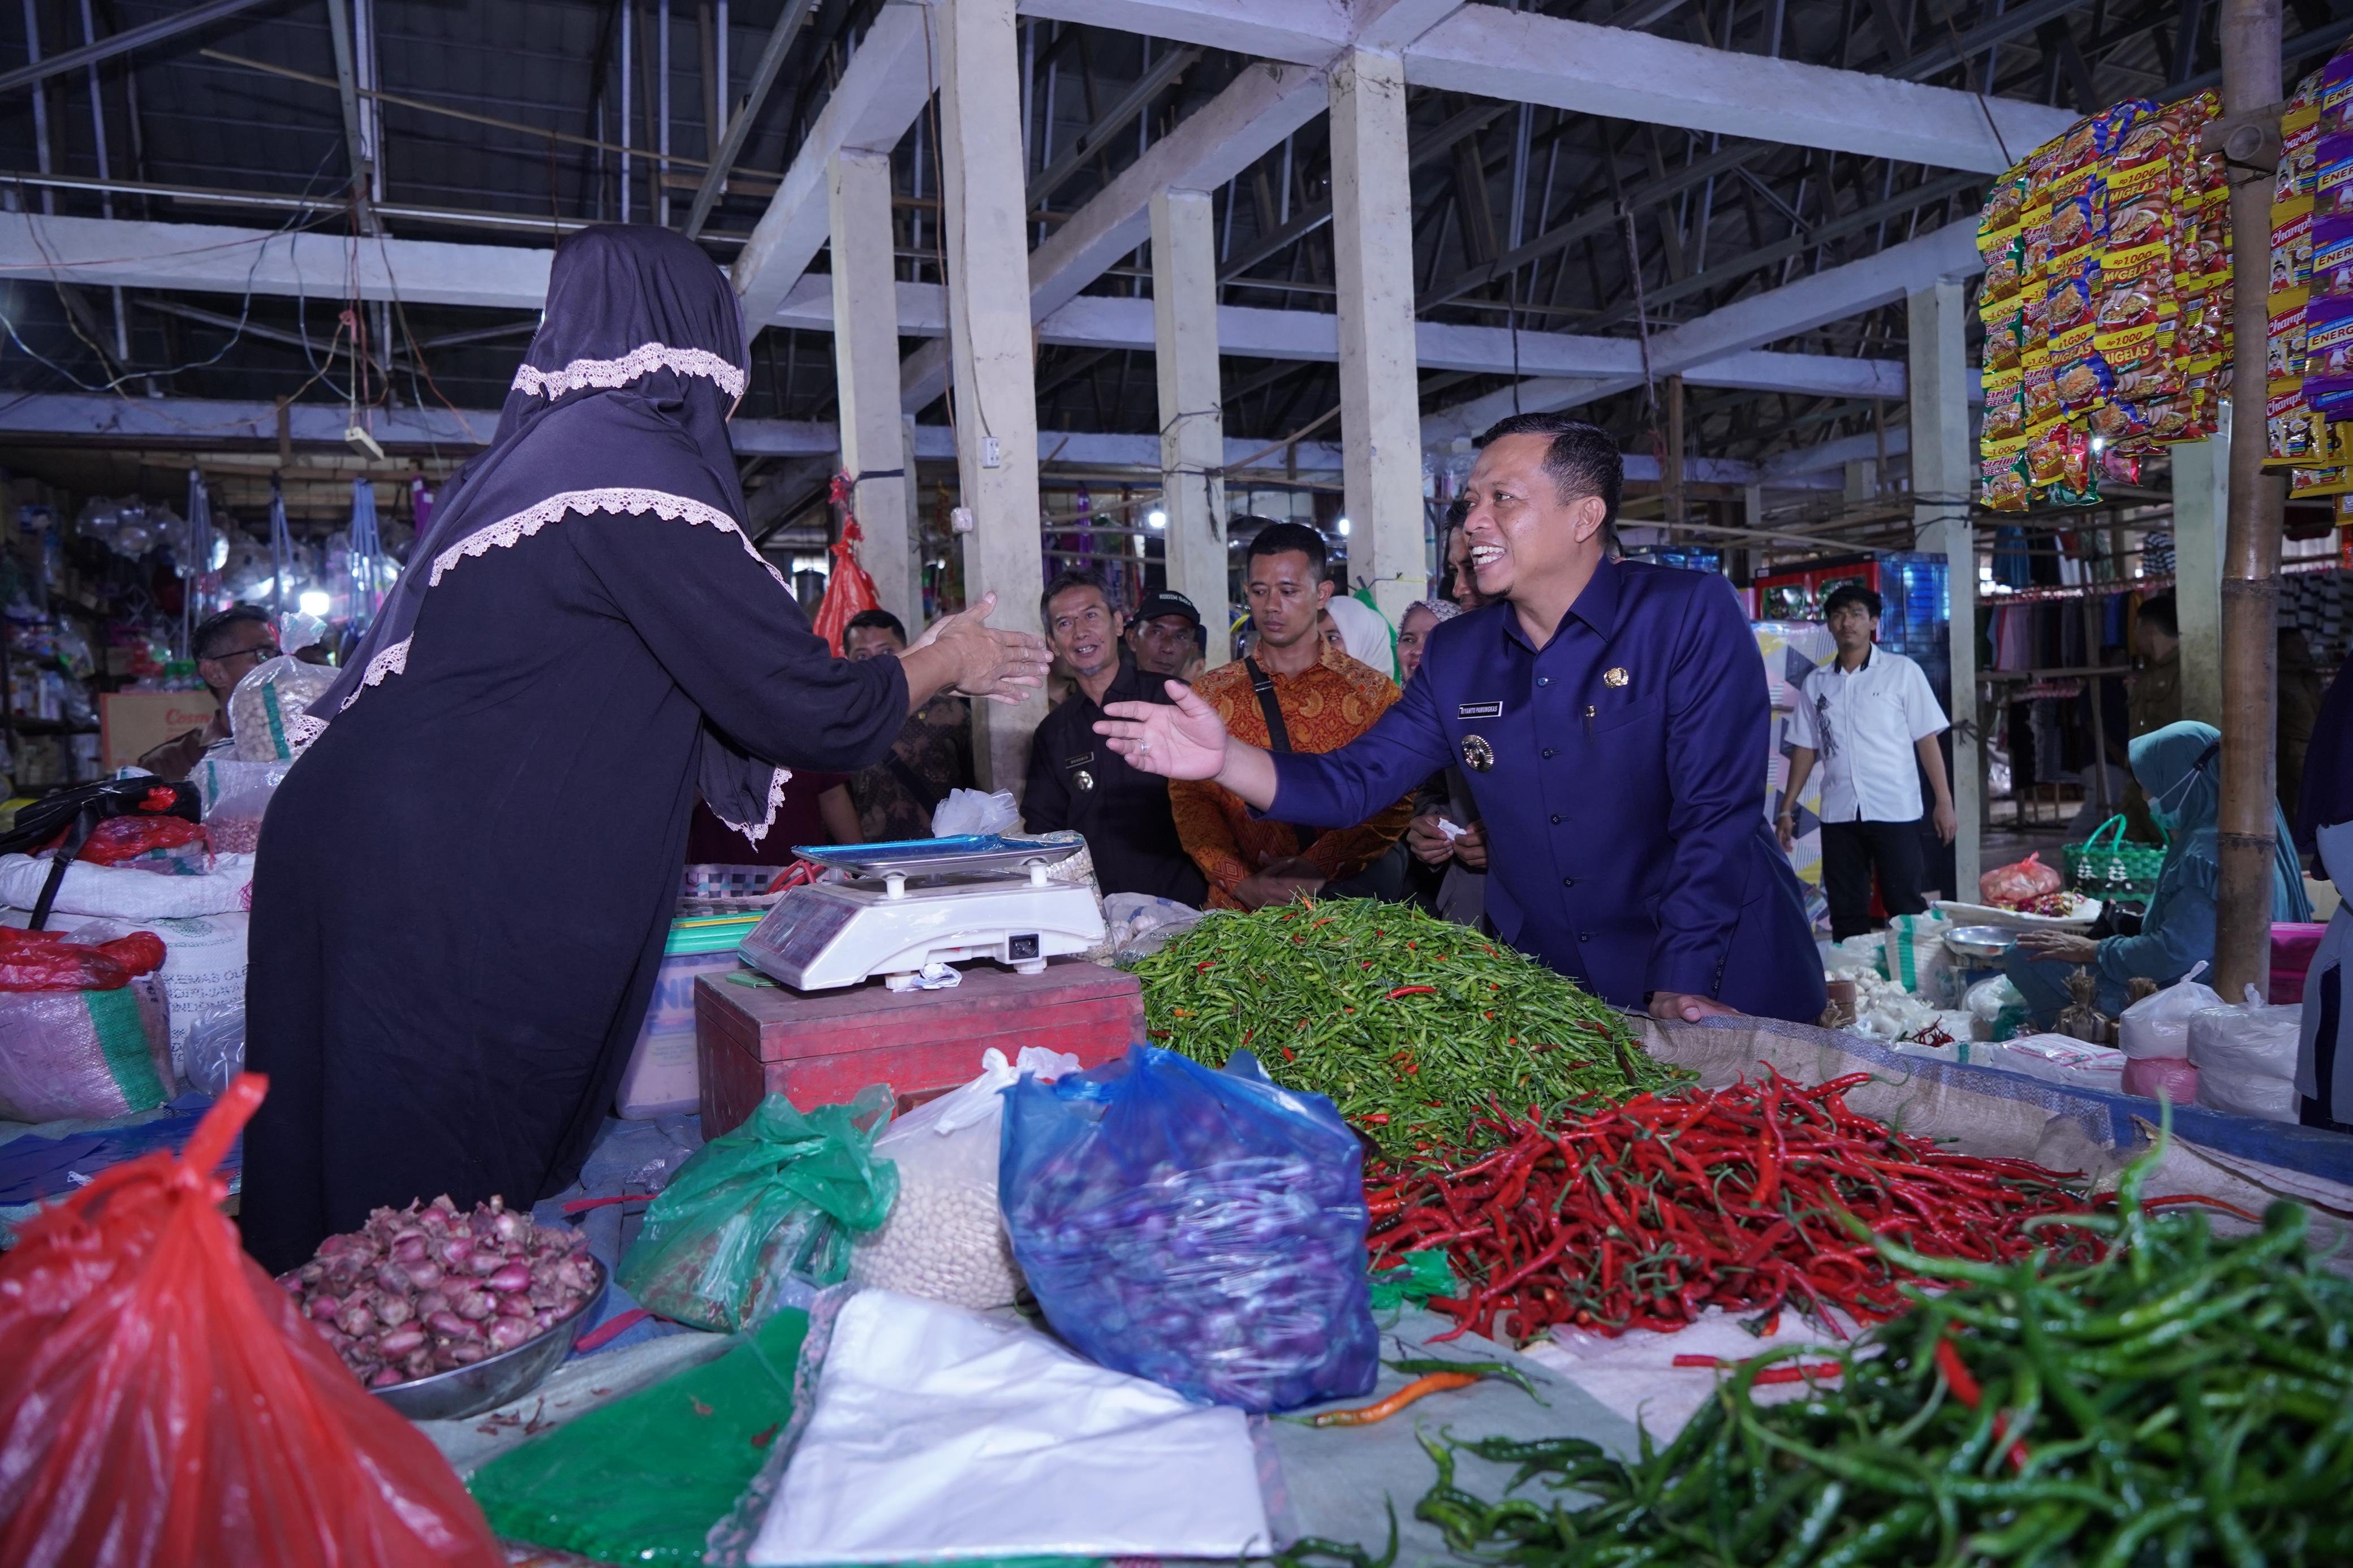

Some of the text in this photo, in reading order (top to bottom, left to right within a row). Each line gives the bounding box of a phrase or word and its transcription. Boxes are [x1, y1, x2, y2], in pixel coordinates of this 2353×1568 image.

[2109, 180, 2156, 204] MIGELAS
[2318, 247, 2353, 266] ENER
[2104, 261, 2152, 282] MIGELAS
[1981, 452, 2020, 469] Sarimi
[1984, 465, 2011, 477] GELAS
